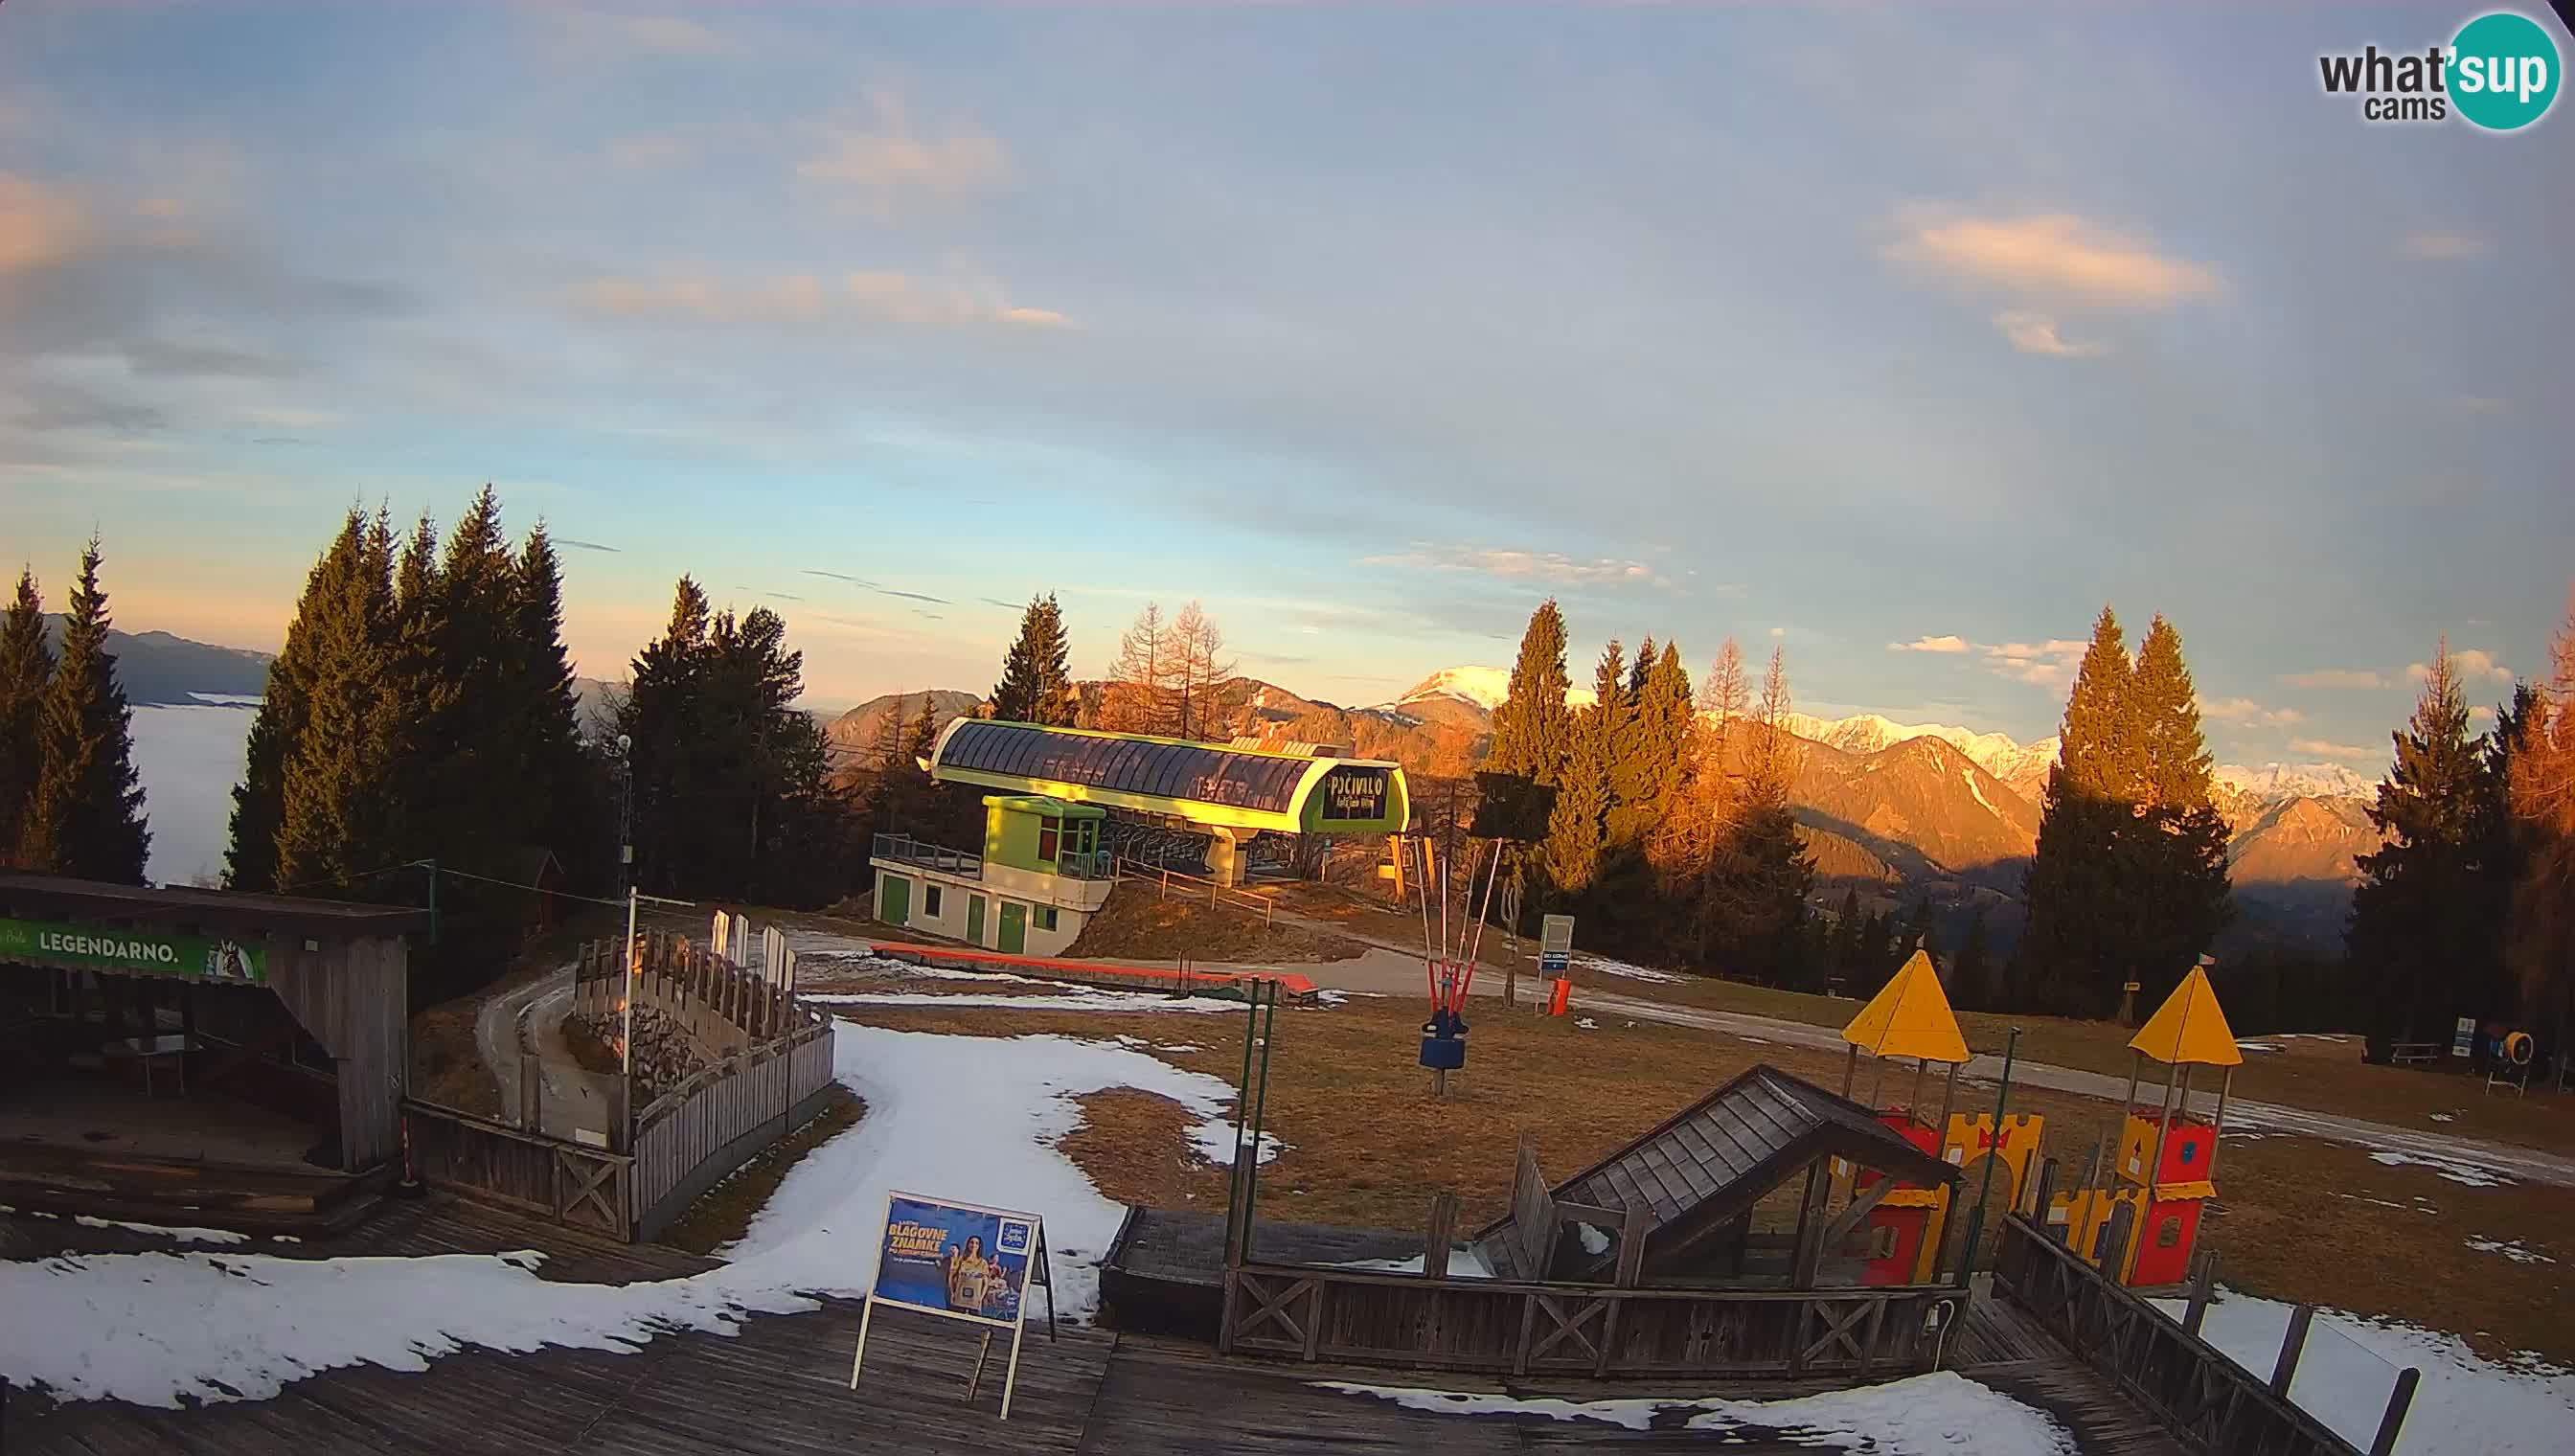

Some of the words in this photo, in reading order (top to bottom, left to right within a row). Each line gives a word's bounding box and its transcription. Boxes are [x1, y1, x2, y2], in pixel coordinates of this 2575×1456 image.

[39, 932, 179, 964] LEGENDARNO.
[889, 1223, 949, 1240] BLAGOVNE
[891, 1236, 942, 1252] ZNAMKE
